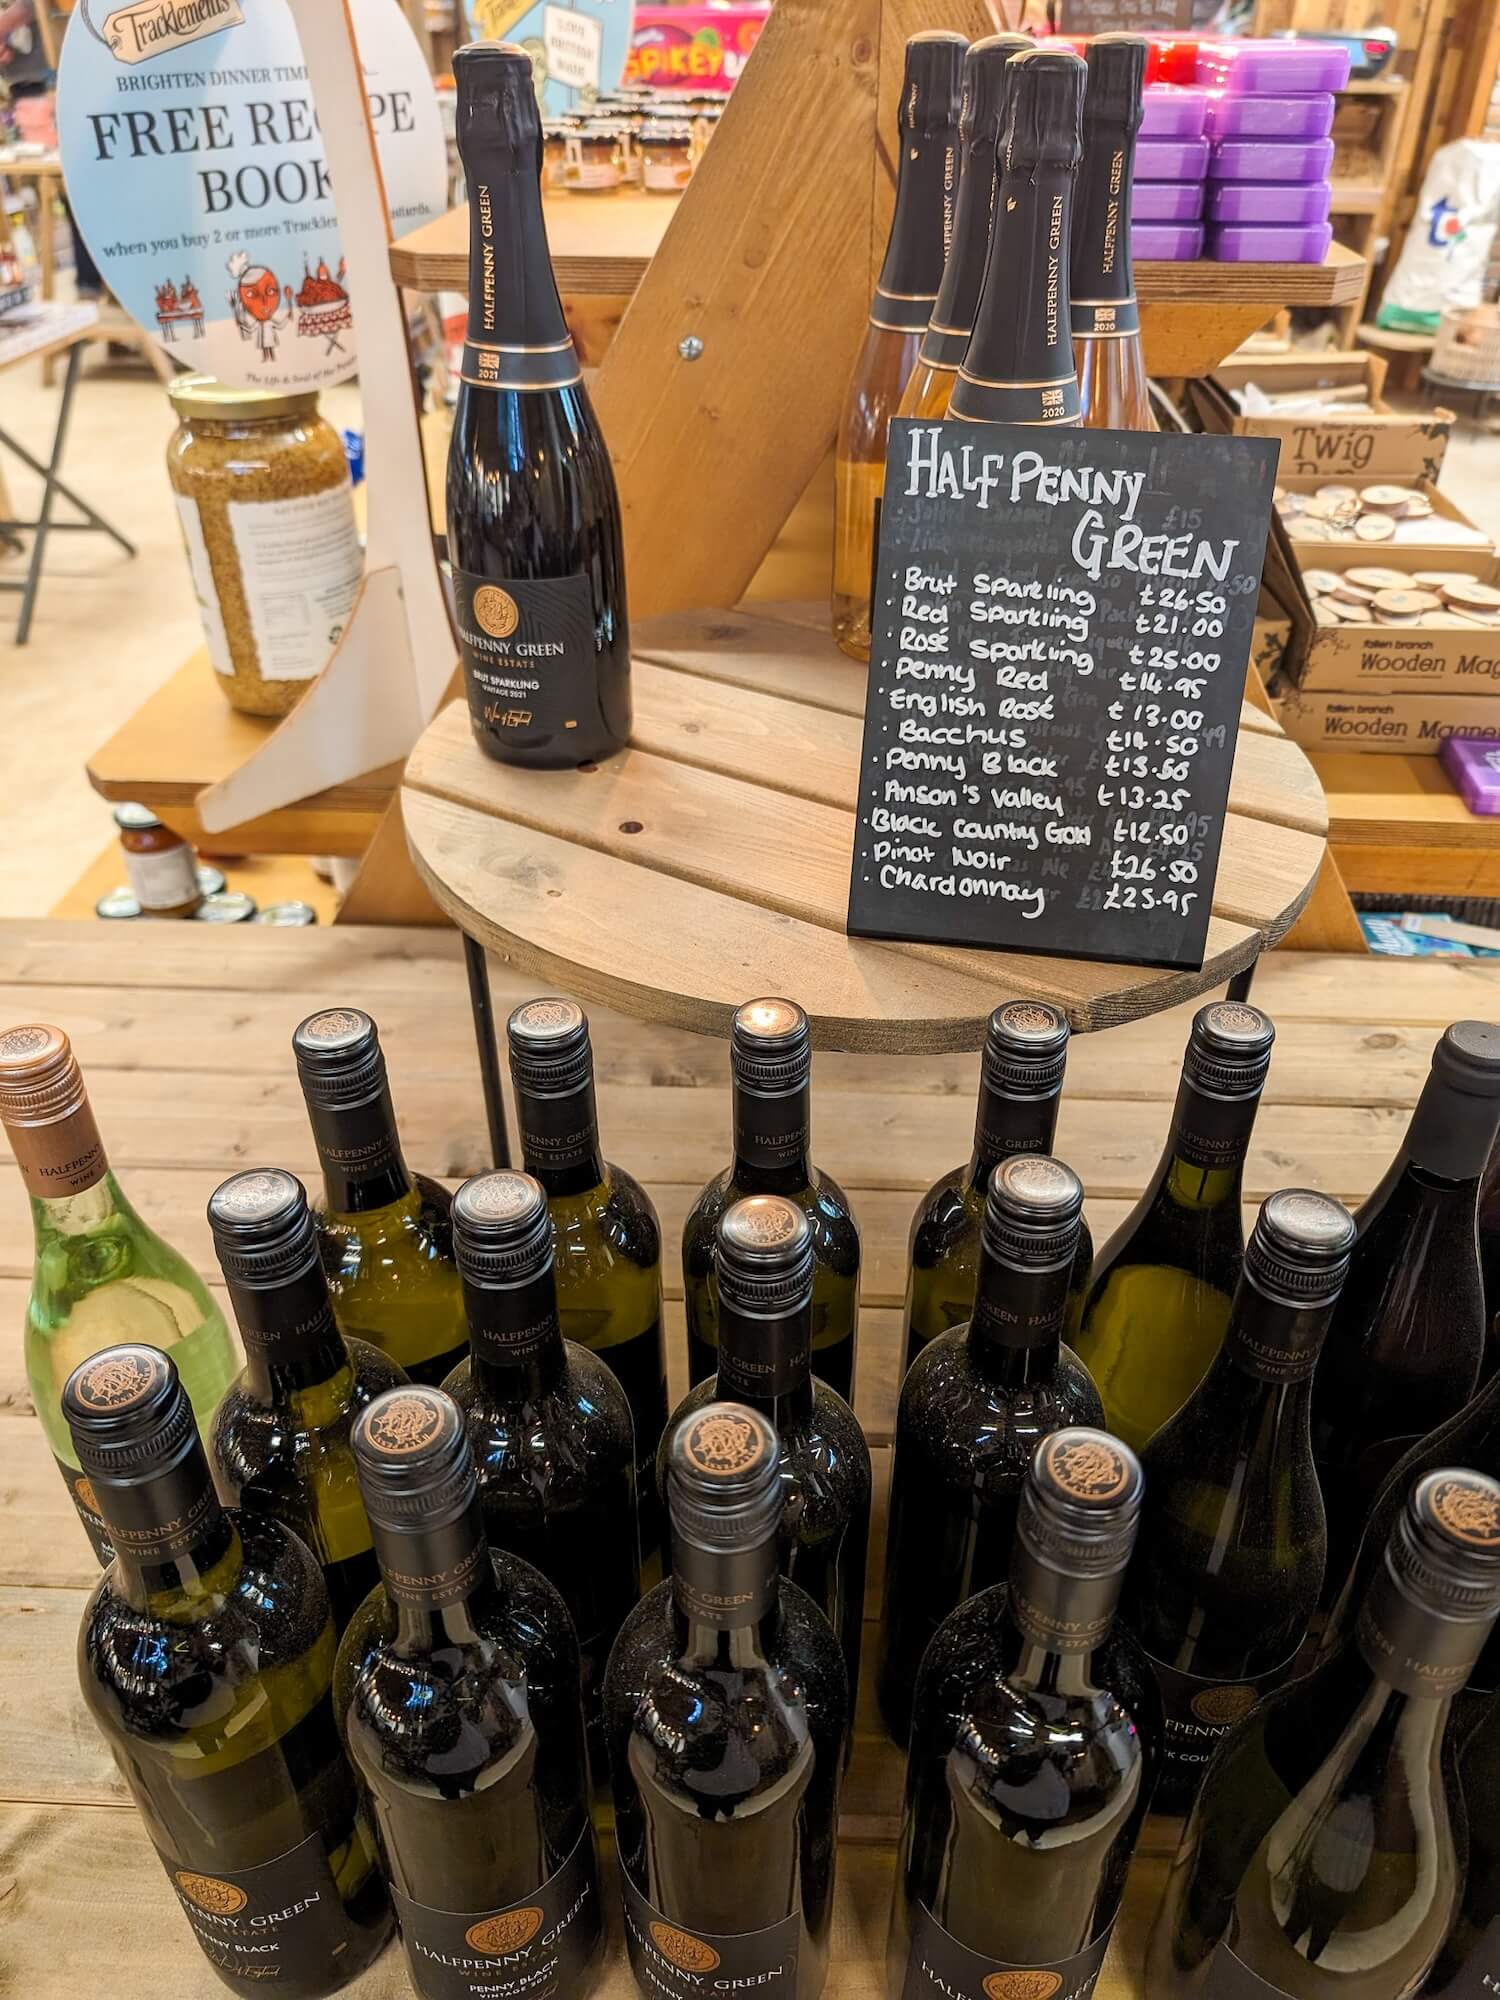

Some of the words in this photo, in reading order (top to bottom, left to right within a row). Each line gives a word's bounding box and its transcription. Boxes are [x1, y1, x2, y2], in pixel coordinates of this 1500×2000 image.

[116, 72, 205, 92] BRIGHTEN
[210, 69, 271, 87] DINNER
[87, 105, 233, 160] FREE
[943, 147, 954, 190] GREEN
[1110, 150, 1124, 195] GREEN
[478, 184, 494, 238] GREEN
[1050, 195, 1064, 251] GREEN
[103, 237, 147, 259] when
[150, 232, 178, 256] you
[182, 229, 210, 250] buy
[213, 230, 222, 244] 2
[225, 230, 240, 242] or
[244, 226, 282, 242] more
[1103, 199, 1119, 274] HALFPENNY
[480, 243, 495, 331] HALFPENNY
[1047, 255, 1059, 346] HALFPENNY
[1093, 321, 1116, 332] 2020
[478, 369, 499, 381] 2021
[1042, 406, 1066, 419] 2020
[1293, 426, 1376, 470] Twig
[1072, 508, 1240, 582] GREEN
[904, 565, 958, 595] Brut
[973, 573, 1097, 616] Sparkling
[1140, 584, 1227, 614] £26.50
[902, 596, 948, 625] Red
[969, 601, 1089, 643] Sparkling
[1136, 613, 1224, 639] £21.00
[516, 641, 566, 657] GREEN
[900, 625, 949, 653] Rosé
[969, 639, 1095, 676] Sparkling
[1395, 639, 1434, 650] branch
[498, 657, 535, 669] ESTATE
[895, 657, 976, 694] Penny
[996, 665, 1049, 692] Red
[1360, 653, 1447, 673] Wooden
[490, 674, 541, 691] SPARKLING
[889, 685, 987, 718] English
[998, 694, 1056, 721] Rosé
[1357, 703, 1395, 715] branch
[899, 718, 1027, 749] Bacchus
[1324, 717, 1409, 737] Wooden
[885, 748, 966, 781] Penny
[982, 751, 1060, 779] Black
[884, 780, 981, 808] Anson's
[990, 788, 1065, 818] Valley
[870, 807, 943, 838] Black
[952, 818, 1041, 851] Country
[1044, 822, 1092, 847] Gold
[874, 836, 936, 866] Pinot
[952, 845, 1012, 872] Noir
[1110, 850, 1199, 885] £26.50
[879, 863, 1047, 920] Chardonnay
[40, 1142, 100, 1178] HALFPENN
[1005, 1136, 1046, 1151] GREEN
[69, 1171, 96, 1188] WINE
[732, 1355, 777, 1374] GREEN
[701, 1591, 754, 1607] GREEN
[249, 1891, 322, 1928] GREEN
[415, 1940, 534, 1971] HALFPENNY
[541, 1881, 591, 1948] GREEN
[235, 1942, 281, 1954] BLACK
[469, 1981, 516, 1994] PENNY
[519, 1956, 560, 1987] BLACK
[714, 1966, 784, 1990] GREEN
